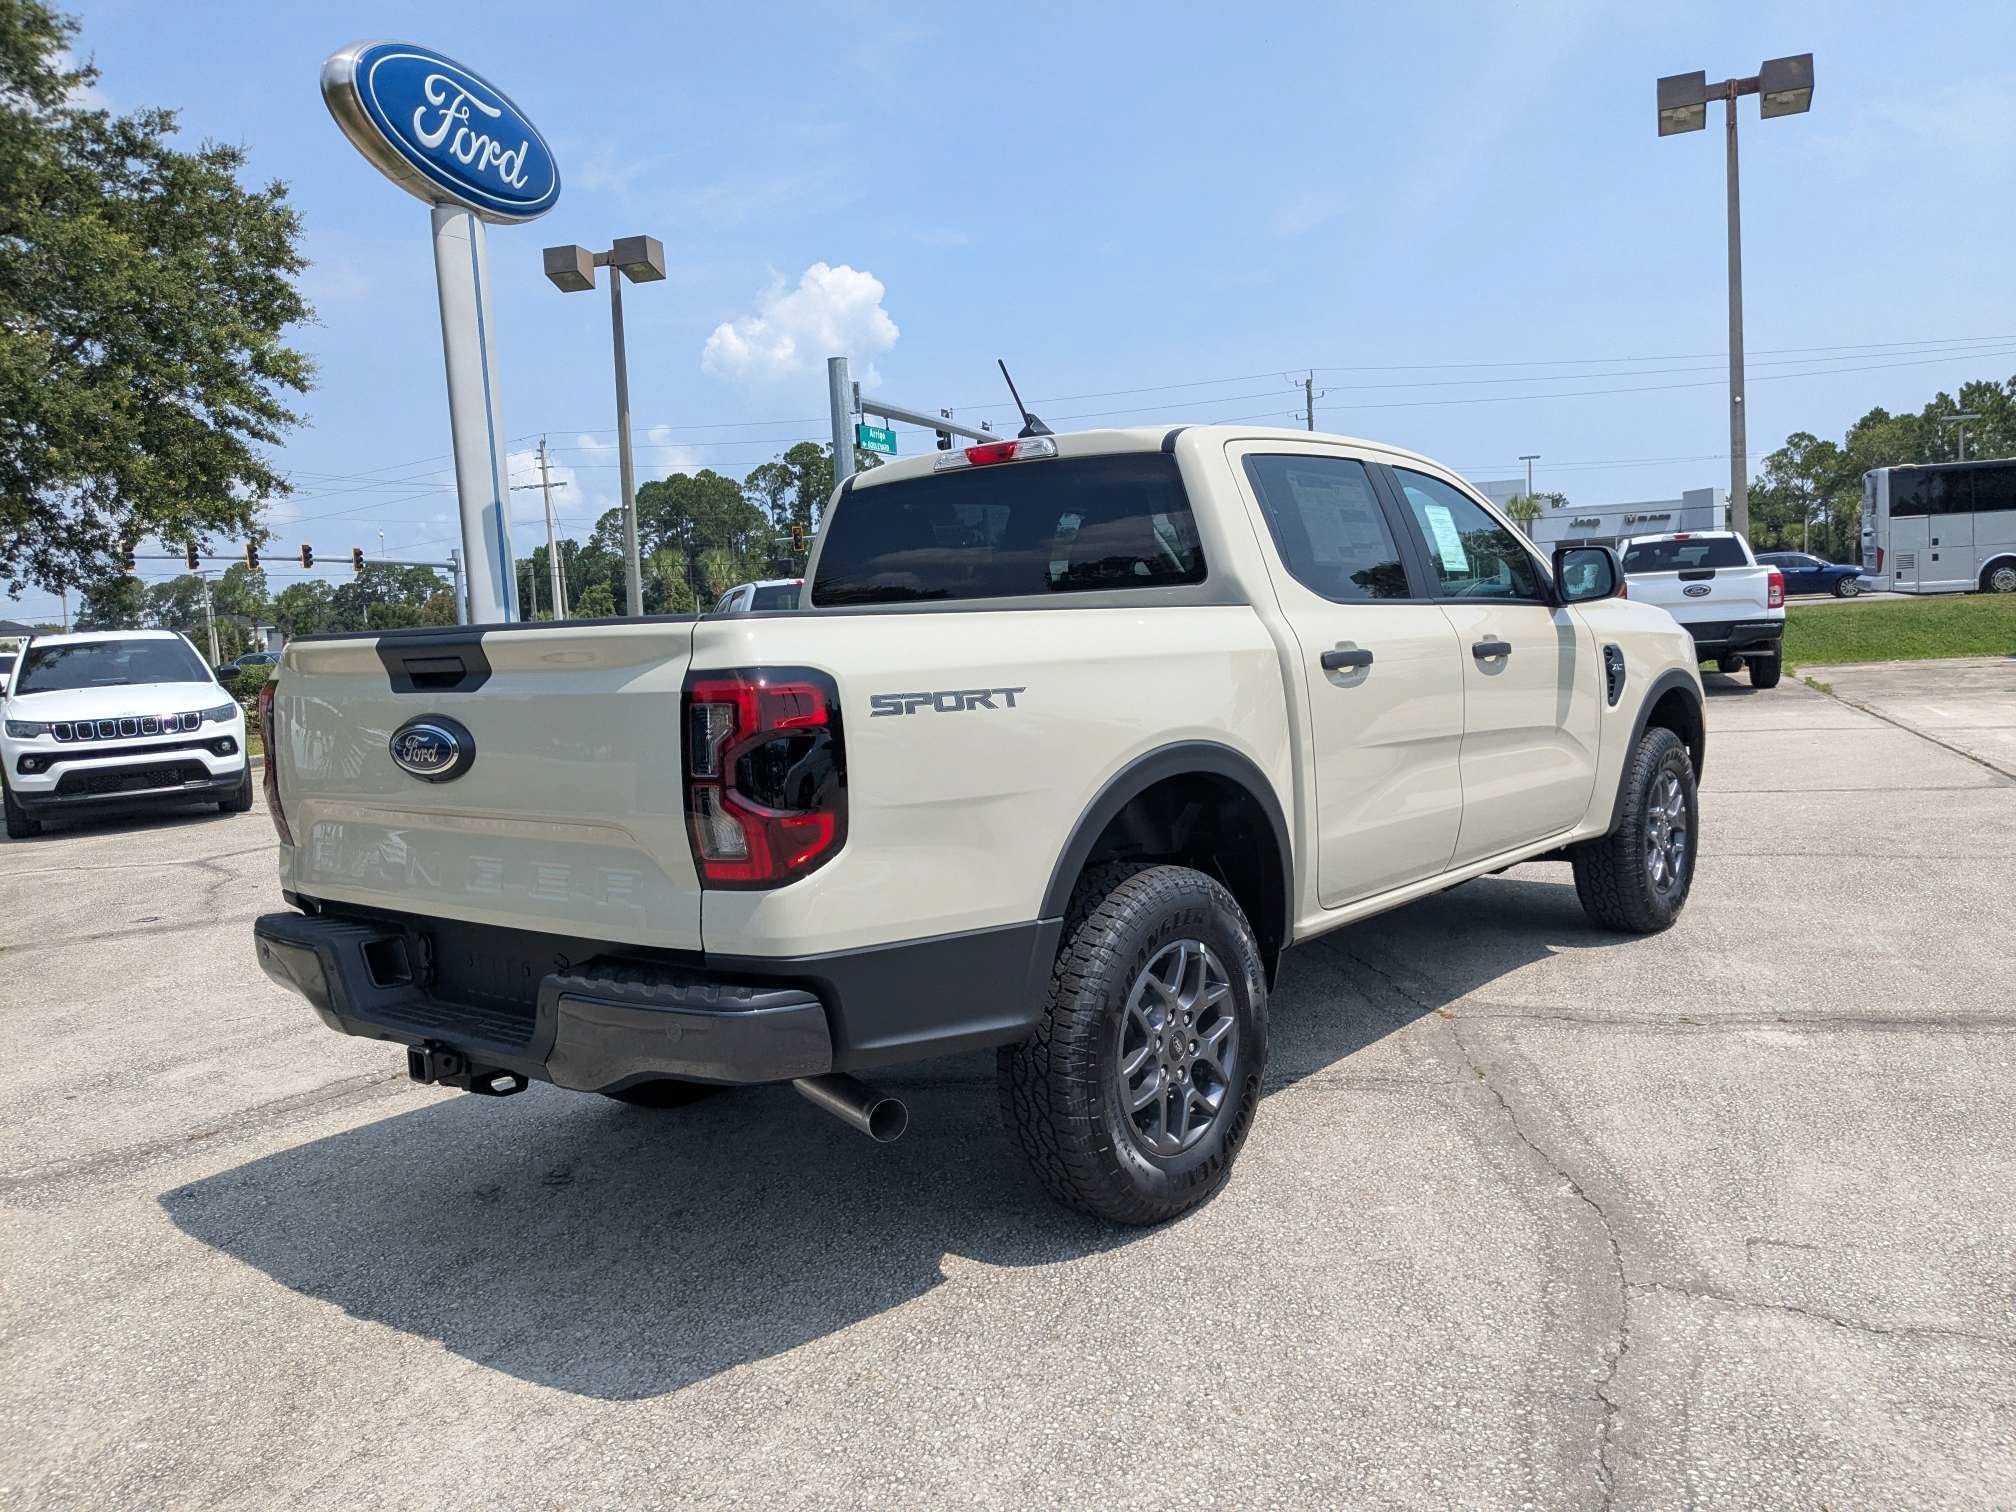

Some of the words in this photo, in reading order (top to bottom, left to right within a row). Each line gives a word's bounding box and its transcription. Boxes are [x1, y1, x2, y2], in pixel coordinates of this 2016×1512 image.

[413, 74, 529, 189] Ford
[1569, 517, 1601, 529] Jeep
[870, 686, 1027, 717] SPORT
[402, 735, 439, 763] Ford
